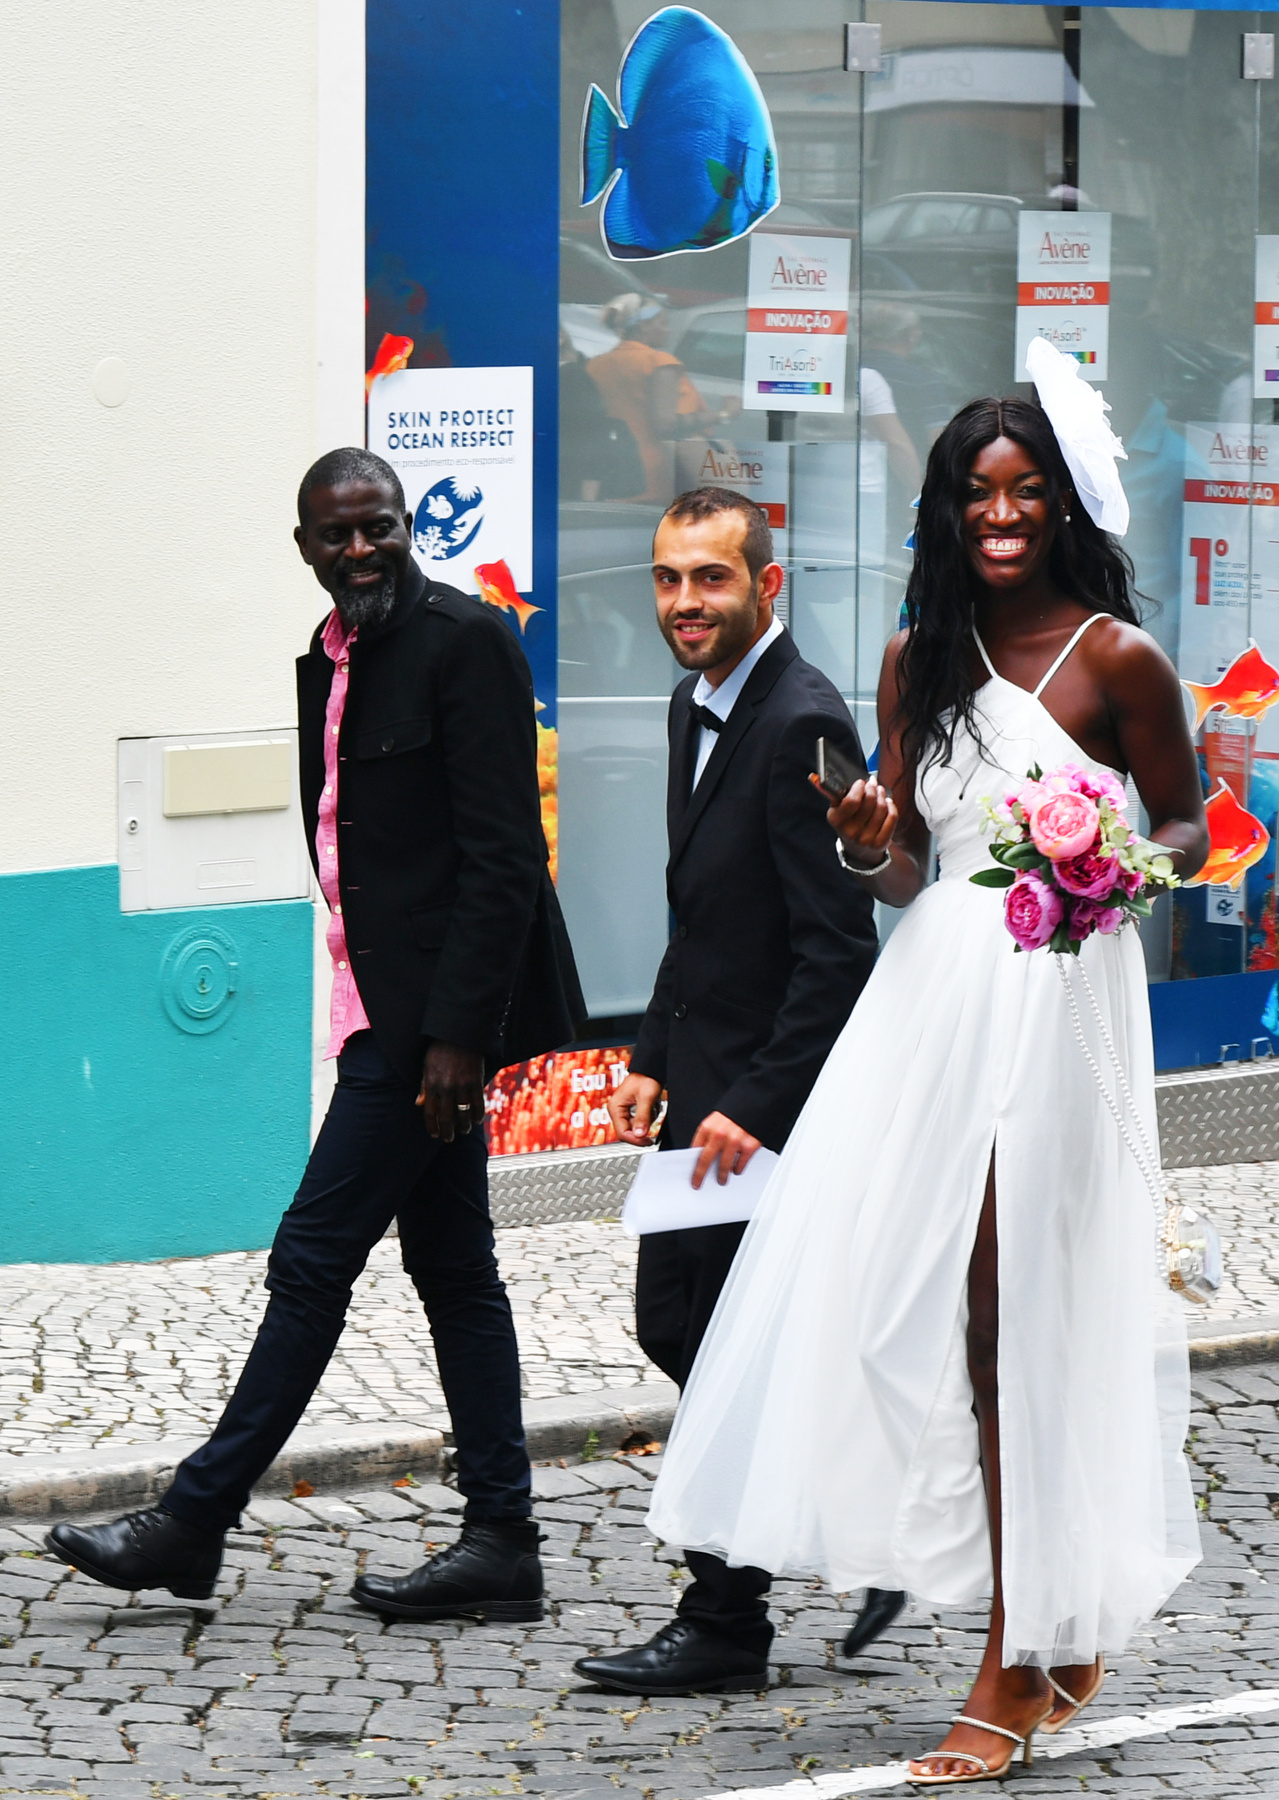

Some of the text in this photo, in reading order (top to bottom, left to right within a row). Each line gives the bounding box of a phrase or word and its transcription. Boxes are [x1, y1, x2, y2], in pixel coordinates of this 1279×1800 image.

[1039, 231, 1091, 259] Avène
[770, 256, 827, 285] Avène
[1034, 283, 1095, 304] INOVAÇÃO
[765, 311, 832, 332] INOVAÇÃO
[388, 408, 514, 428] SKIN PROTECT
[388, 430, 514, 450] OCEAN RESPECT
[1209, 432, 1269, 461] Avène
[700, 449, 764, 479] Avène
[1204, 482, 1274, 501] INOVAÇÃO
[570, 1068, 606, 1093] Eau
[570, 1111, 585, 1128] a
